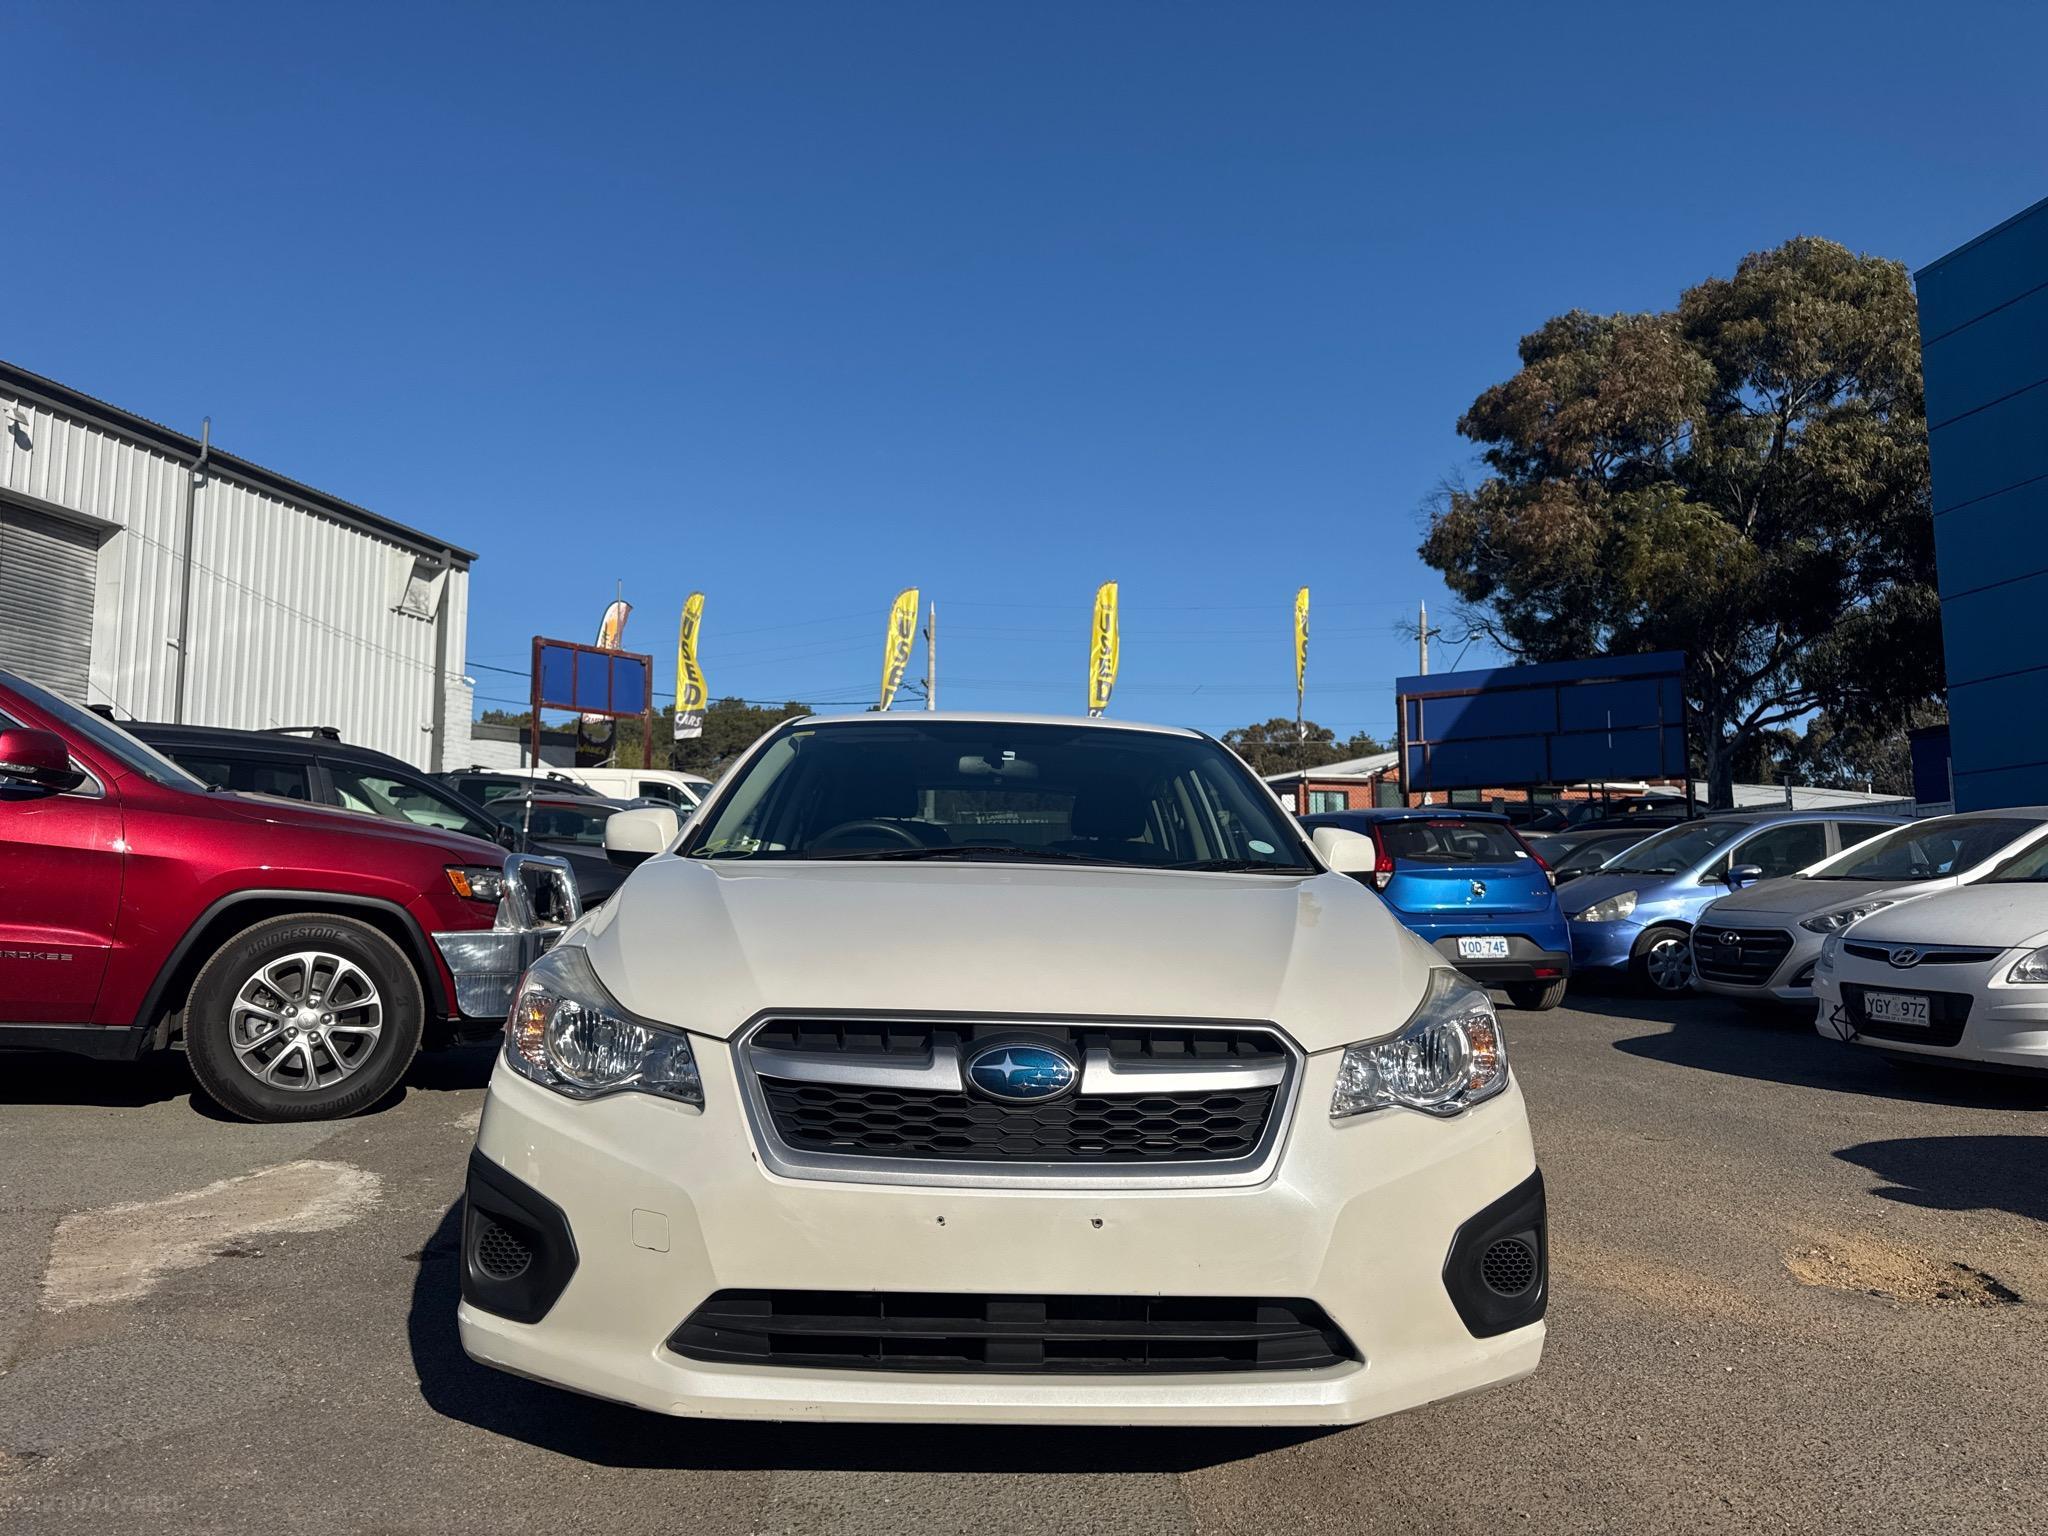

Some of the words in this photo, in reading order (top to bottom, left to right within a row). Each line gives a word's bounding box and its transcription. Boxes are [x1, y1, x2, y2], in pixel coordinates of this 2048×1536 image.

[681, 617, 702, 706] USED
[675, 712, 702, 728] CARS
[246, 927, 345, 957] BRIDGESTONE
[0, 950, 73, 961] ROKEE
[1867, 997, 1891, 1014] YGY
[1901, 1001, 1926, 1018] 97Z
